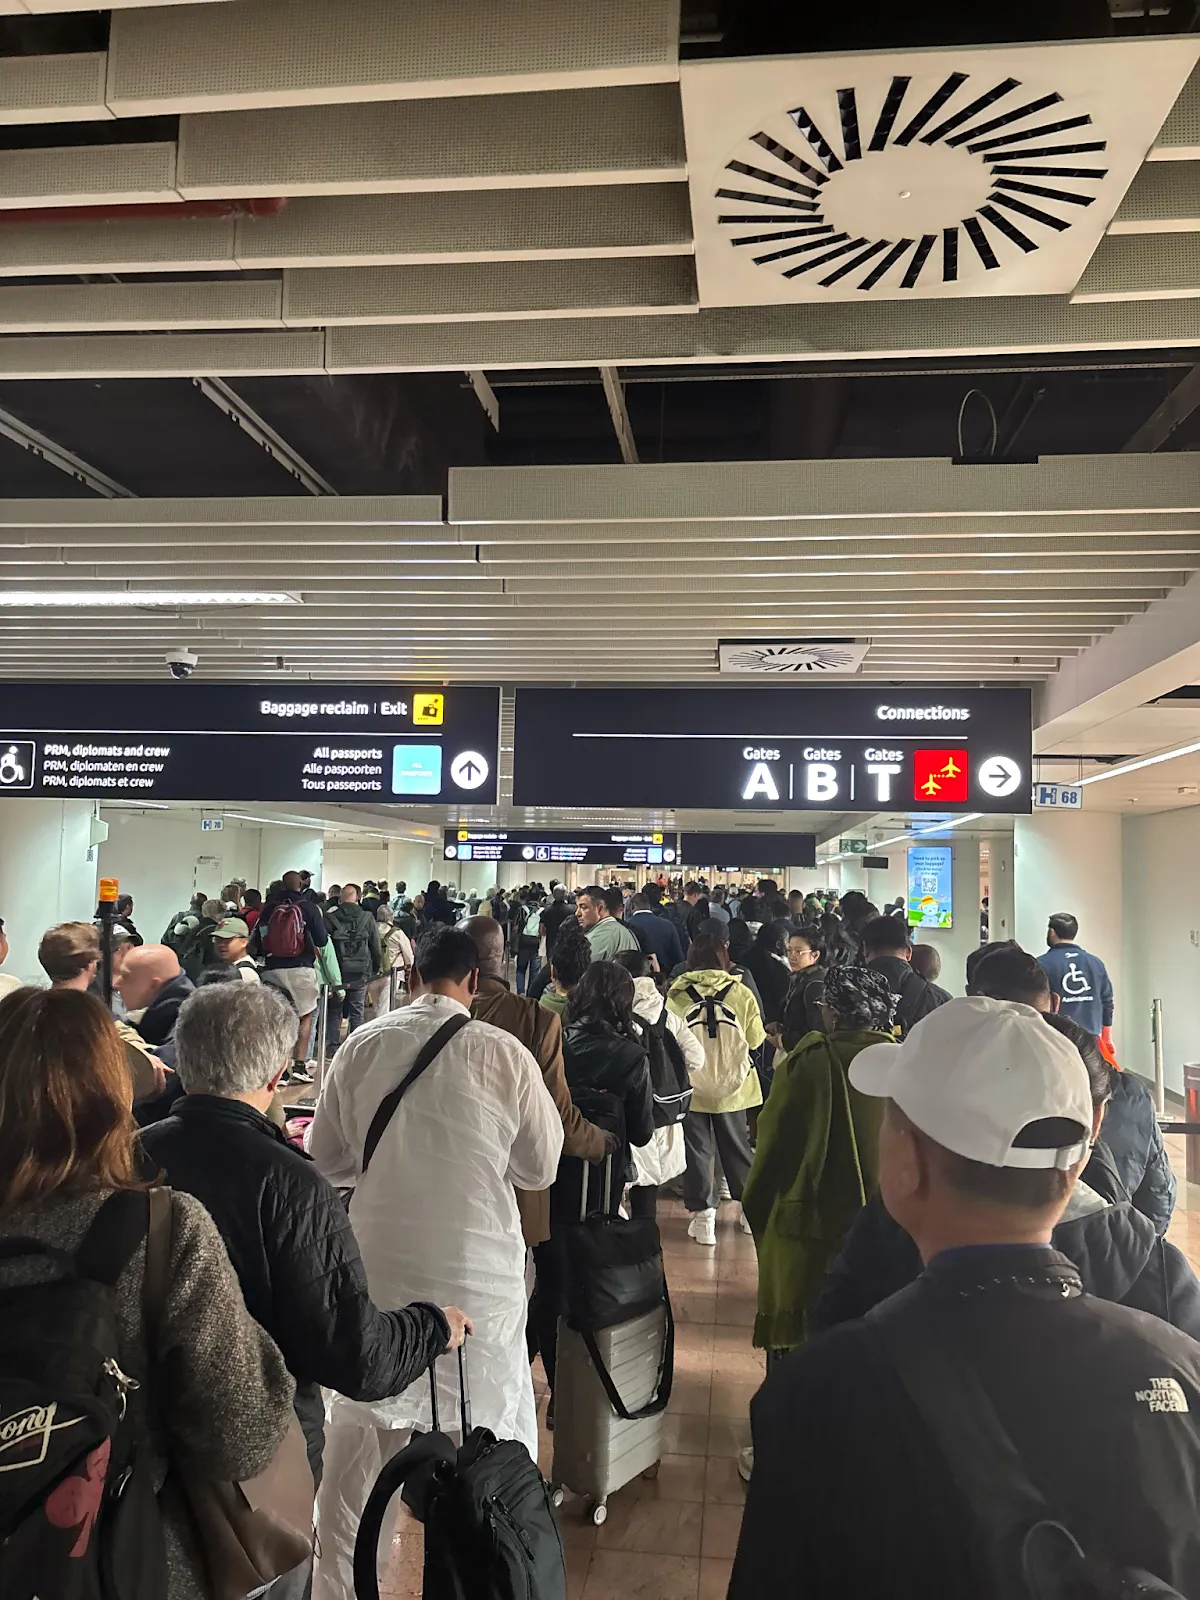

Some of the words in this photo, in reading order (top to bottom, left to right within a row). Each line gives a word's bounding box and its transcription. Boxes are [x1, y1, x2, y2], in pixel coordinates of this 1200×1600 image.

[261, 701, 318, 717] Baggage
[320, 701, 368, 714] reclaim
[381, 702, 407, 715] Exit
[877, 706, 970, 720] Connections
[45, 745, 71, 757] PRM,
[72, 744, 122, 757] diplomats
[124, 745, 143, 756] and
[144, 747, 170, 756] crew
[314, 747, 329, 758] All
[331, 749, 382, 760] passports
[743, 747, 780, 760] Gates
[804, 748, 841, 760] Gates
[865, 748, 904, 761] Gates
[44, 761, 68, 772] PRM,
[70, 760, 125, 773] diplomaten
[125, 763, 139, 772] en
[139, 763, 164, 773] crew
[303, 763, 322, 774] Alle
[324, 765, 381, 775] paspoorten
[43, 776, 67, 787] PRM,
[69, 776, 116, 788] diplomats
[118, 777, 128, 787] et
[130, 779, 153, 787] crew
[302, 779, 325, 789] Tous
[327, 780, 381, 791] passeports
[742, 763, 779, 800] A
[805, 763, 838, 801] B
[866, 764, 901, 802] T
[1061, 791, 1078, 805] 68
[1149, 1377, 1171, 1389] THE
[1134, 1388, 1174, 1402] NORTH
[1149, 1400, 1177, 1413] FACE
